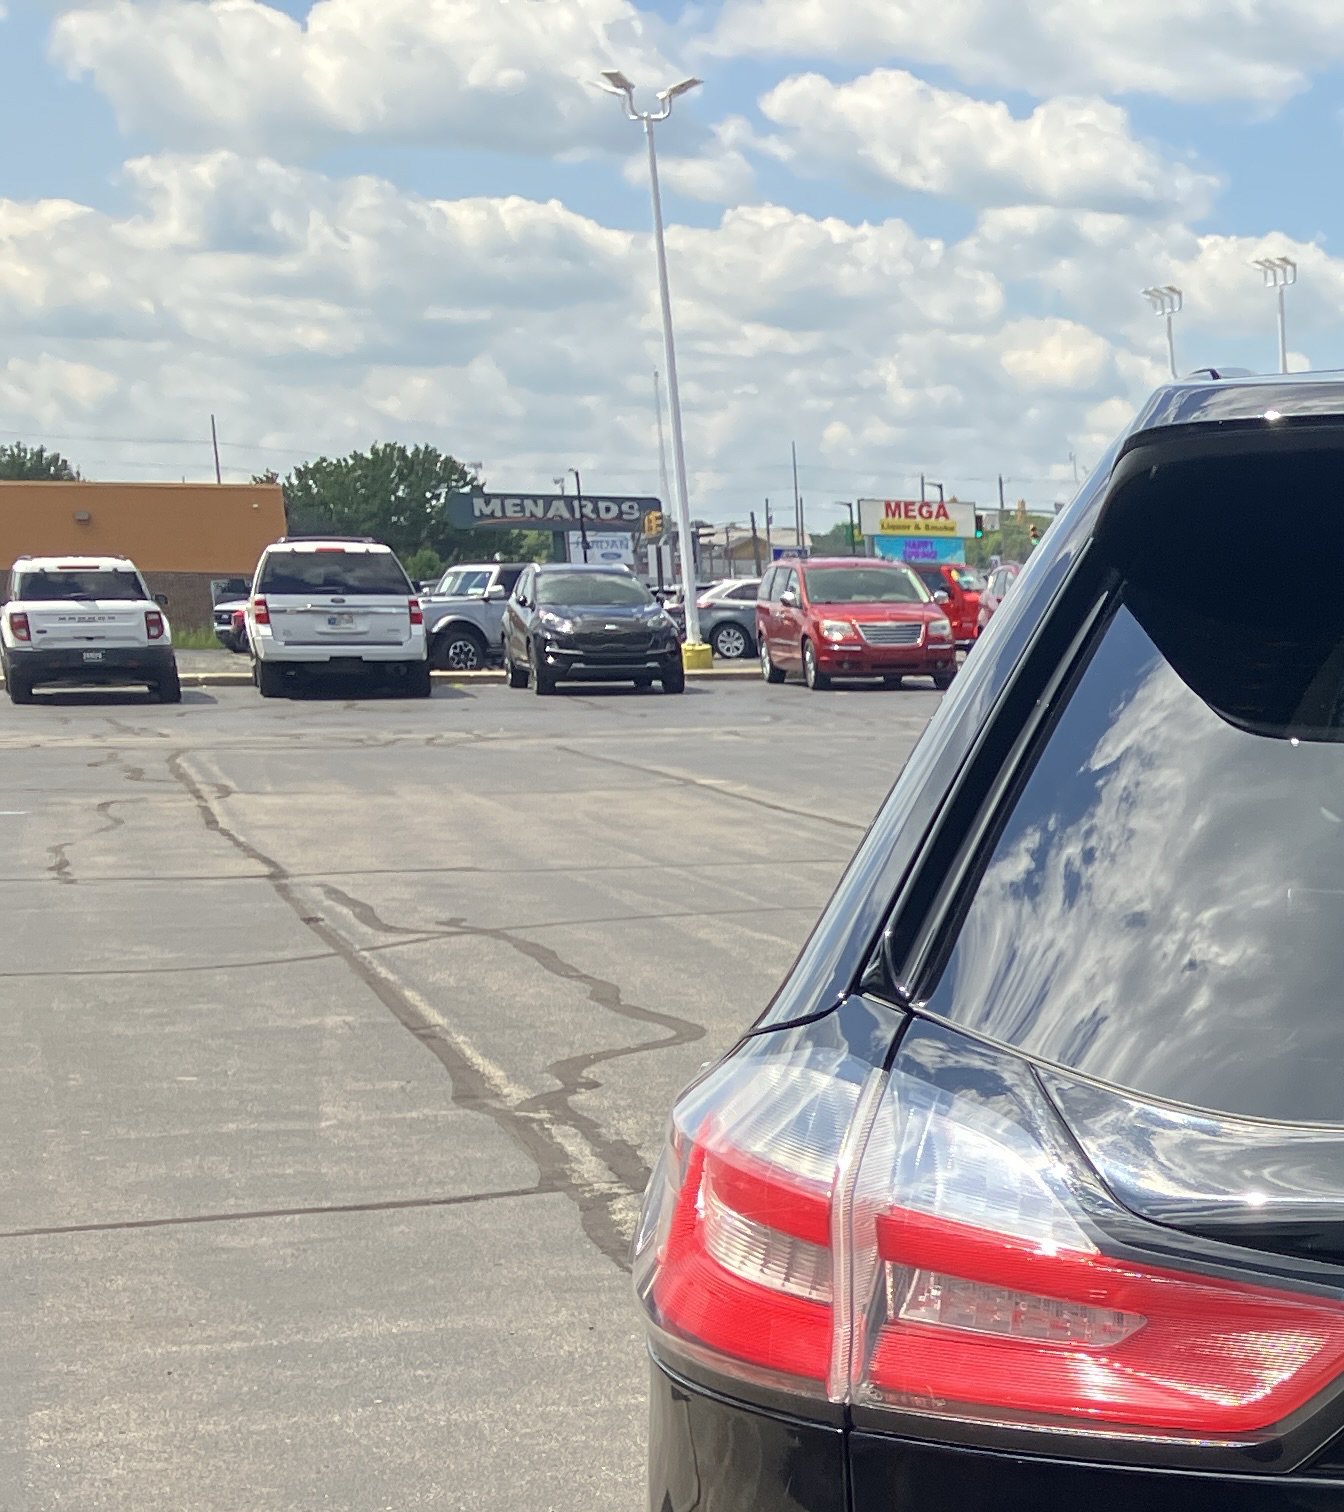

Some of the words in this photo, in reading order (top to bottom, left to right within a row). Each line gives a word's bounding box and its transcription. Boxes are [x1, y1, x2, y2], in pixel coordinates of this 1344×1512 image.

[472, 497, 641, 520] MENARDS
[884, 500, 950, 520] MEGA
[570, 537, 629, 550] JRDAN
